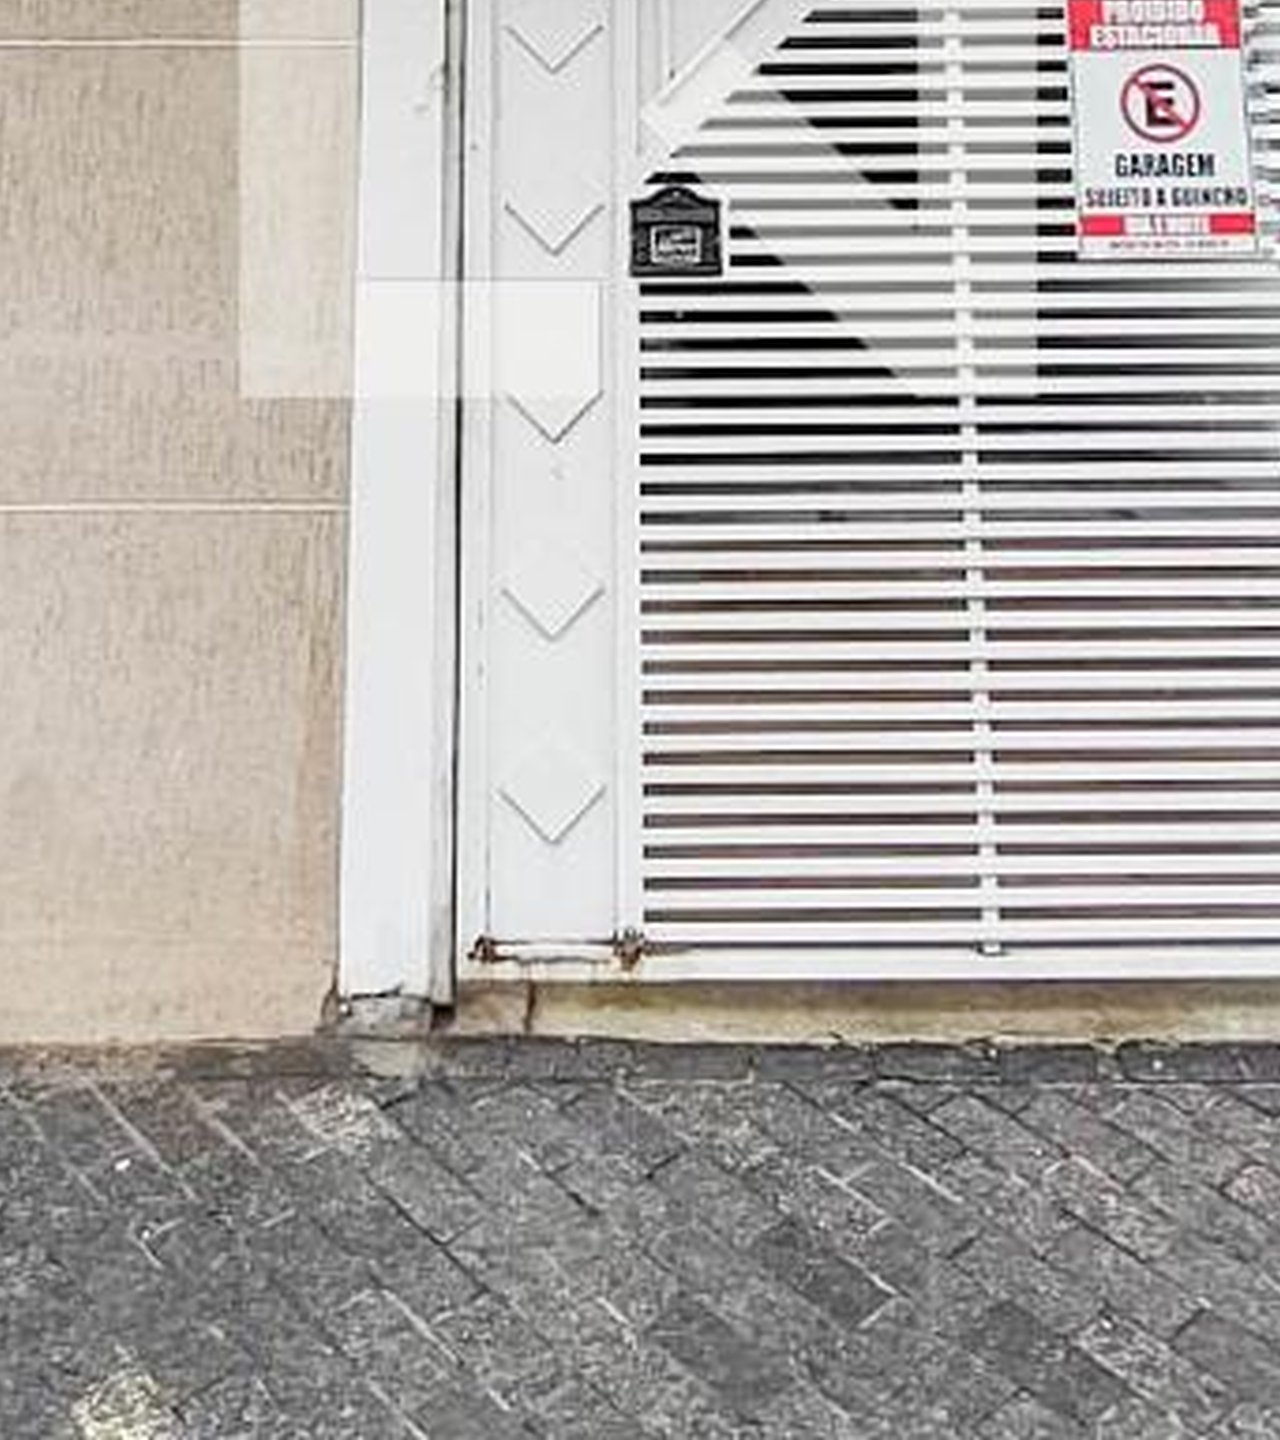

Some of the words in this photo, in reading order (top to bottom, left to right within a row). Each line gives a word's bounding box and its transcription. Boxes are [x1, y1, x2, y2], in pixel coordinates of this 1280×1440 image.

[1115, 153, 1215, 177] GARAGEM
[1085, 187, 1152, 207] SUJEITO
[1171, 187, 1248, 207] GUINCHO
